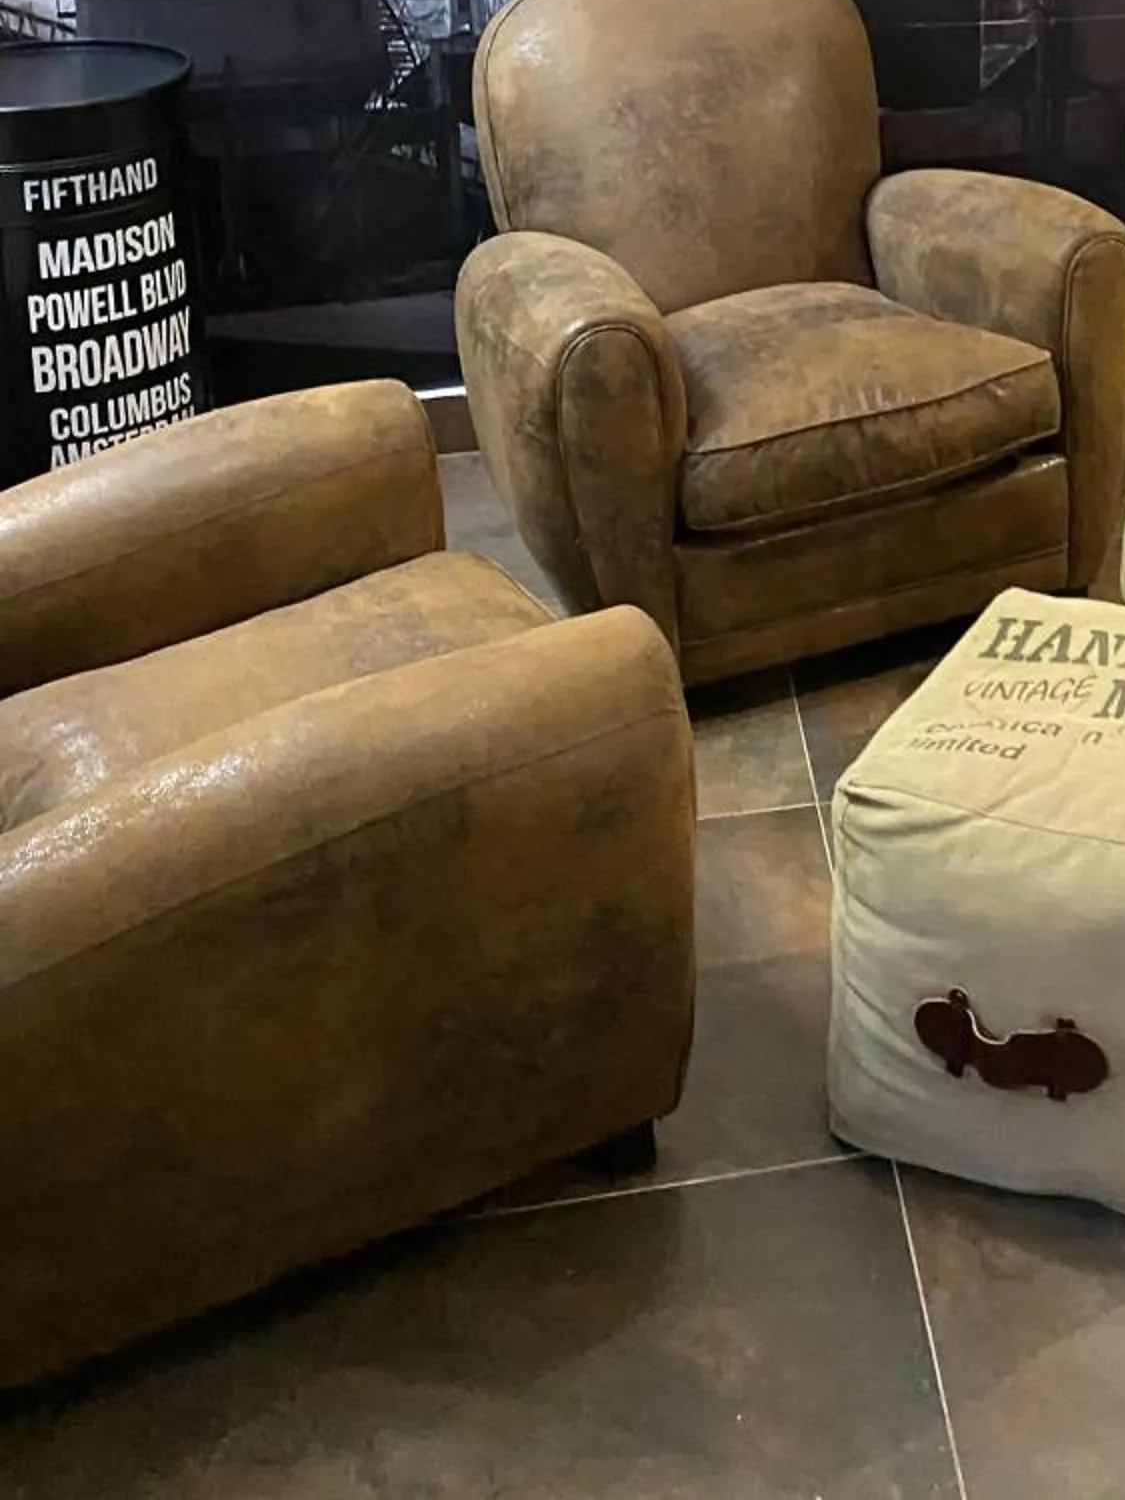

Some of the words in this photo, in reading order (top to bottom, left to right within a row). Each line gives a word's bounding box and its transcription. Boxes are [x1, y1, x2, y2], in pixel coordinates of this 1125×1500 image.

[24, 158, 158, 211] FIFTHAND
[38, 213, 175, 279] MADISON
[28, 280, 137, 334] POWELL
[140, 259, 187, 312] BLVD
[32, 306, 191, 393] BROADWAY
[50, 372, 192, 441] COLUMBUS
[964, 673, 1097, 702] VINTAGE
